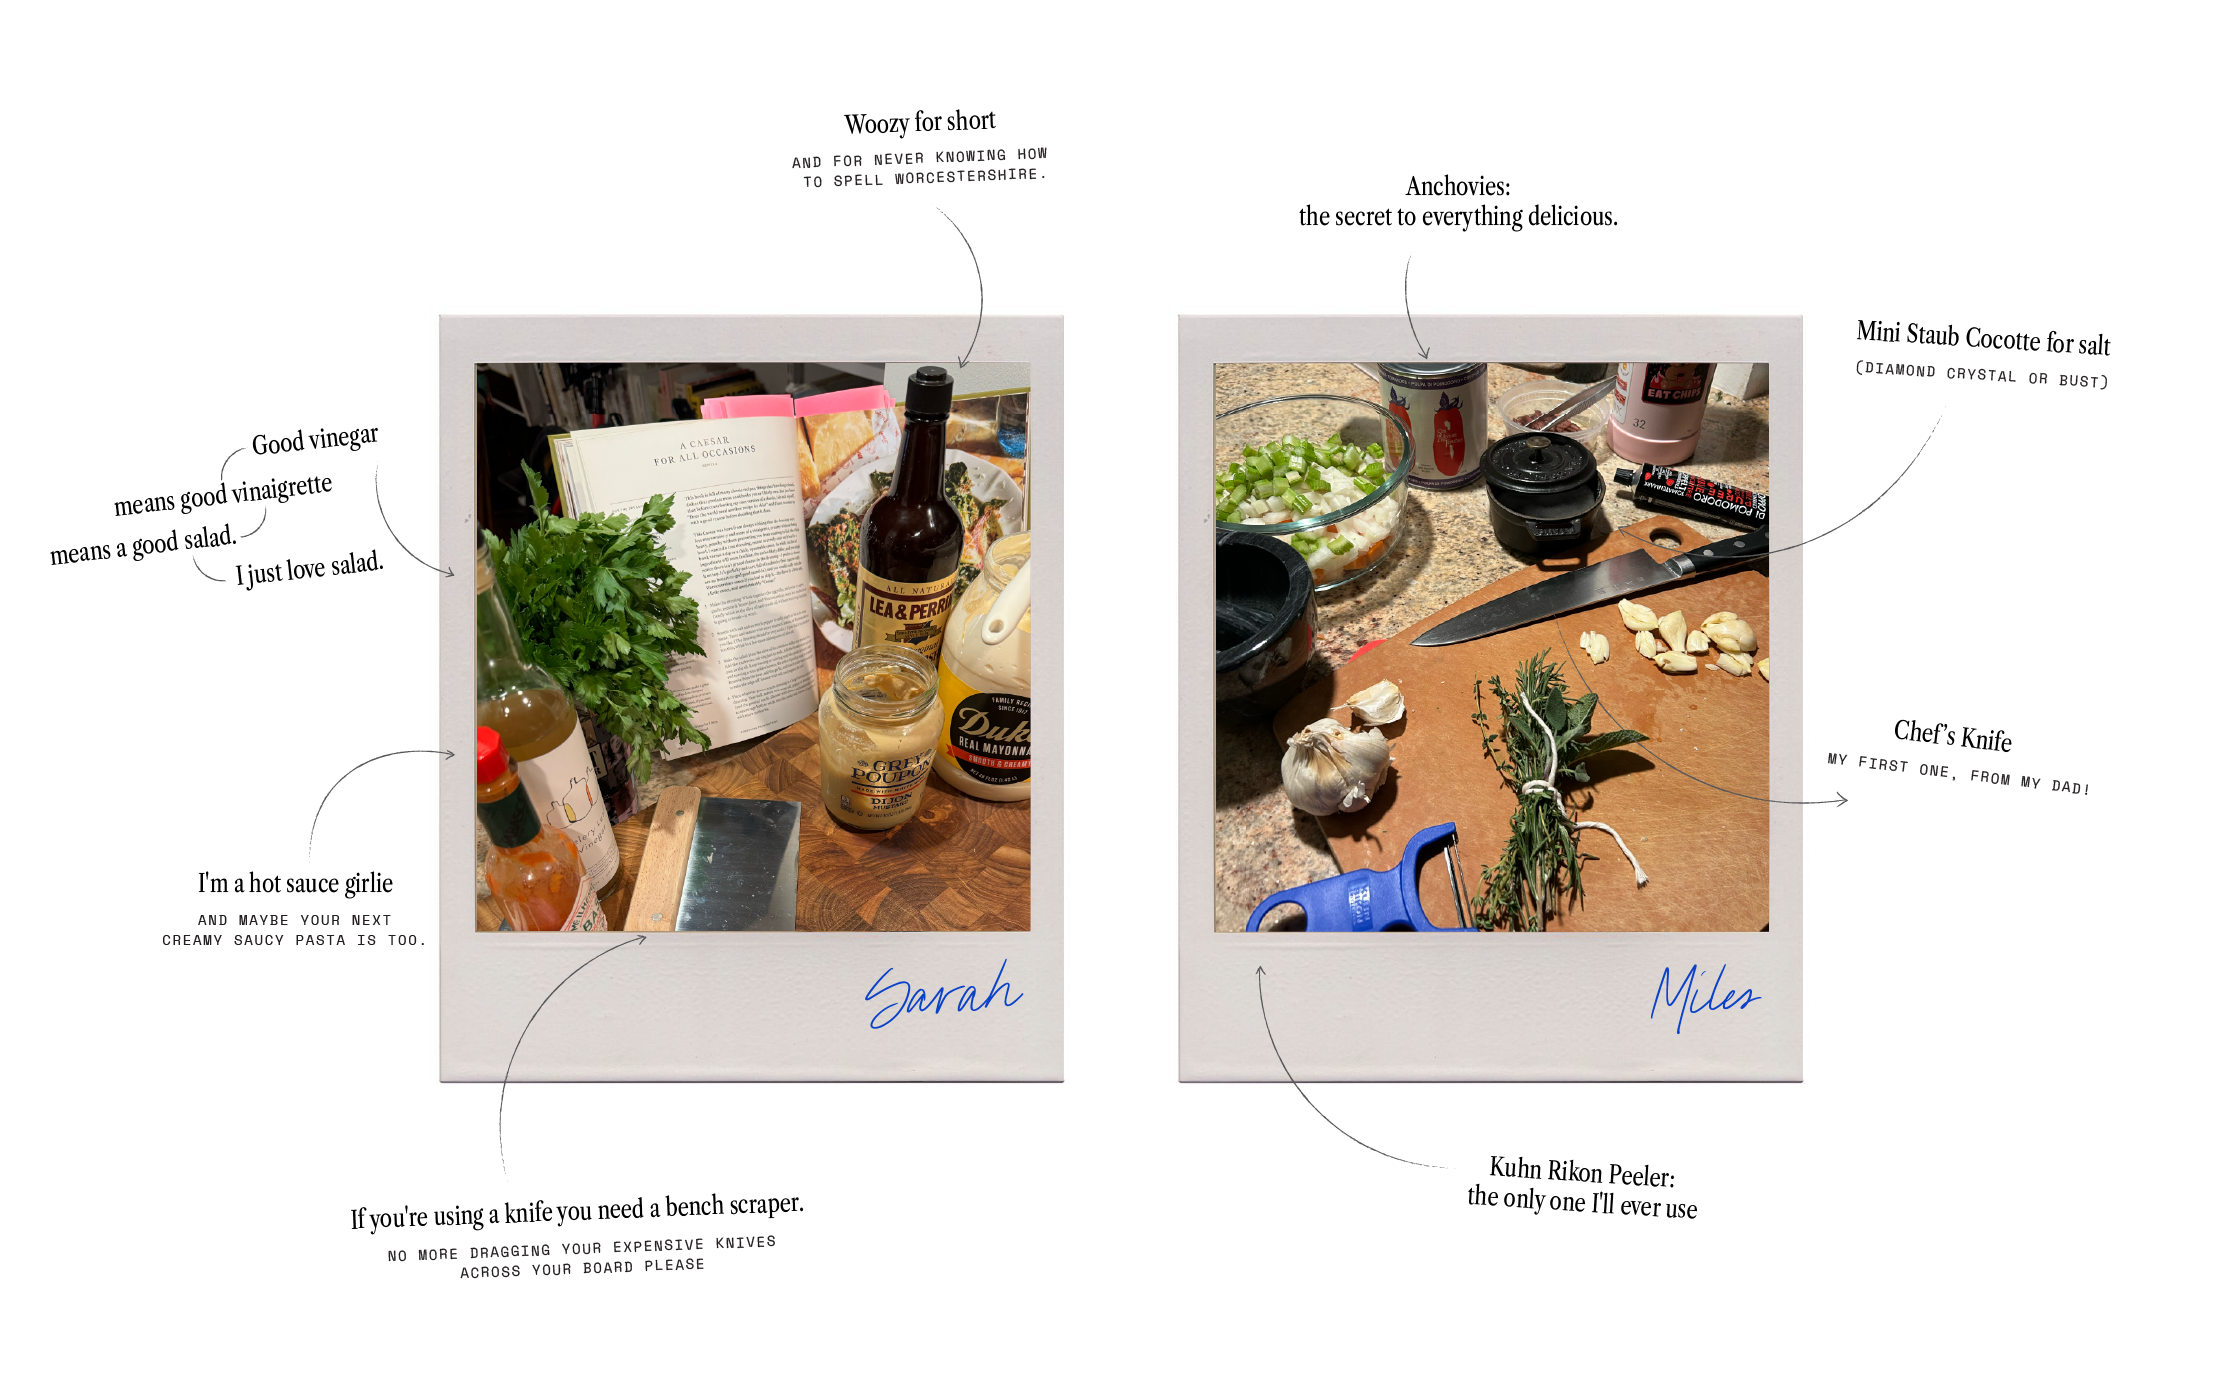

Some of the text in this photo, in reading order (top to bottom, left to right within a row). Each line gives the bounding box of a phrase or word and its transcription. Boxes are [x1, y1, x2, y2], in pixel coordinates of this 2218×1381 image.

[1647, 387, 1702, 400] EAT CHIPS
[1632, 417, 1647, 430] 32
[689, 436, 730, 449] CAESAR
[653, 445, 756, 467] FOR ALL OCCASIONS
[1693, 492, 1753, 517] POMODORO
[911, 580, 953, 595] NATURA
[959, 735, 980, 752] REAL
[968, 754, 995, 767] SMOOTH
[871, 791, 913, 805] DIJON
[865, 958, 1024, 1030] Sarah
[1650, 963, 1762, 1035] Miles
